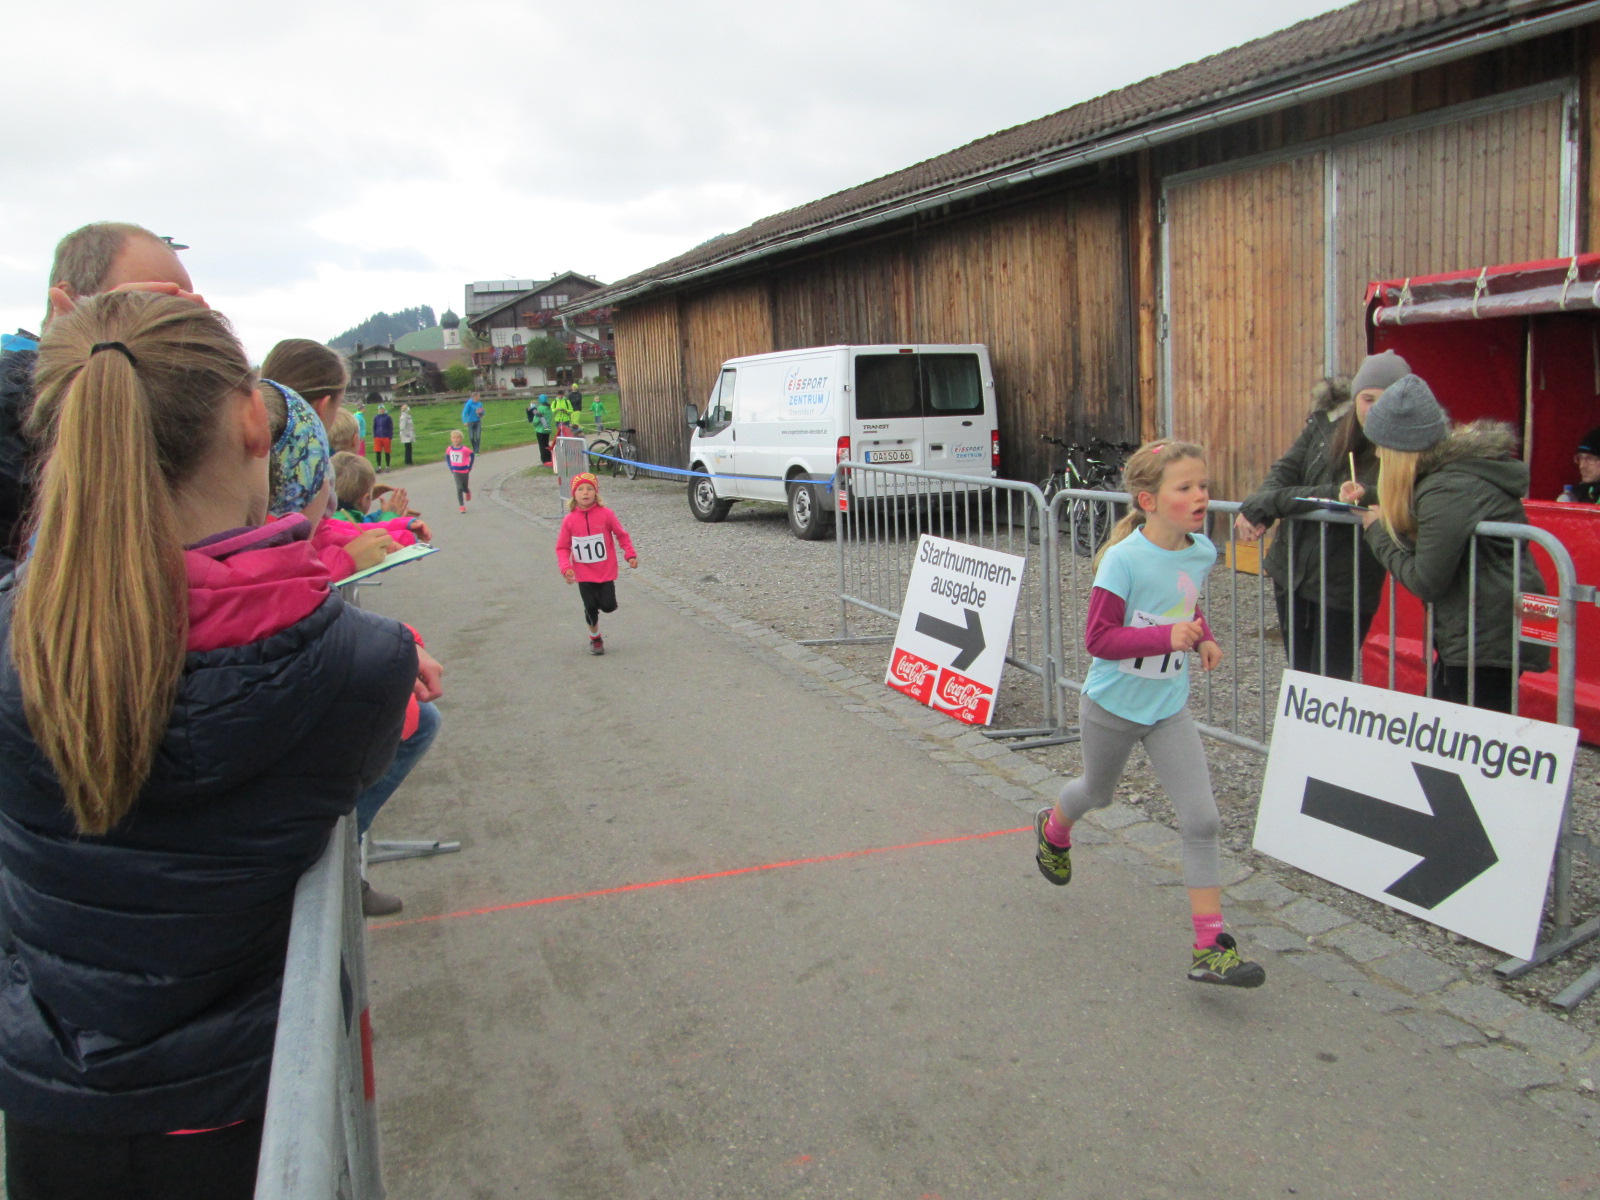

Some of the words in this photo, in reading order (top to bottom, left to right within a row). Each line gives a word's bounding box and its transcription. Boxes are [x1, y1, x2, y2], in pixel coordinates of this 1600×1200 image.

[788, 393, 824, 406] ZENTRUM
[451, 454, 460, 462] 17
[873, 452, 884, 461] OA
[900, 451, 910, 460] 66
[574, 541, 605, 560] 110
[920, 540, 1017, 586] Startnummern-
[931, 575, 987, 608] ausgabe
[1284, 685, 1558, 784] Nachmeldungen
